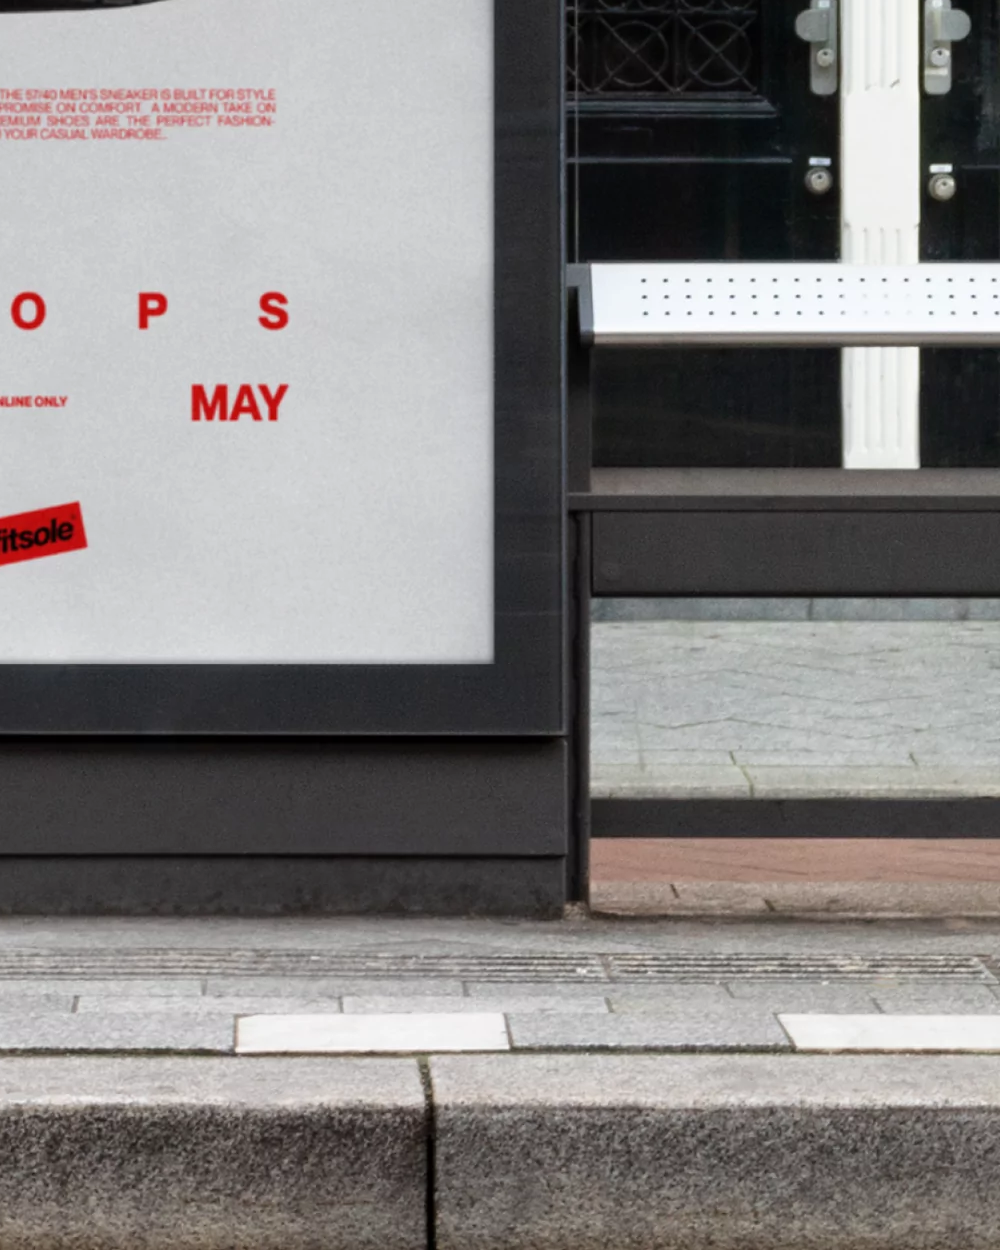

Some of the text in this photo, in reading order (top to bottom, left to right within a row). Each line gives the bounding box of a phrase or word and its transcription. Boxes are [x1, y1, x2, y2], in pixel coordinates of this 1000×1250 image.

[0, 88, 23, 101] THE
[60, 88, 98, 101] MEN'S
[100, 88, 158, 101] SNEAKER
[173, 88, 207, 101] BUILT
[208, 88, 235, 101] FOR
[236, 88, 276, 101] STYLE
[56, 101, 76, 114] ON
[151, 101, 161, 114] A
[163, 101, 218, 114] MODERN
[223, 101, 253, 114] TAKE
[257, 101, 277, 114] ON
[46, 114, 90, 127] SHOES
[95, 114, 120, 127] ARE
[127, 114, 151, 127] THE
[156, 114, 212, 127] PERFECT
[4, 127, 38, 140] YOUR
[40, 127, 89, 140] CASUAL
[34, 395, 67, 408] ONLY
[191, 383, 289, 422] MAY
